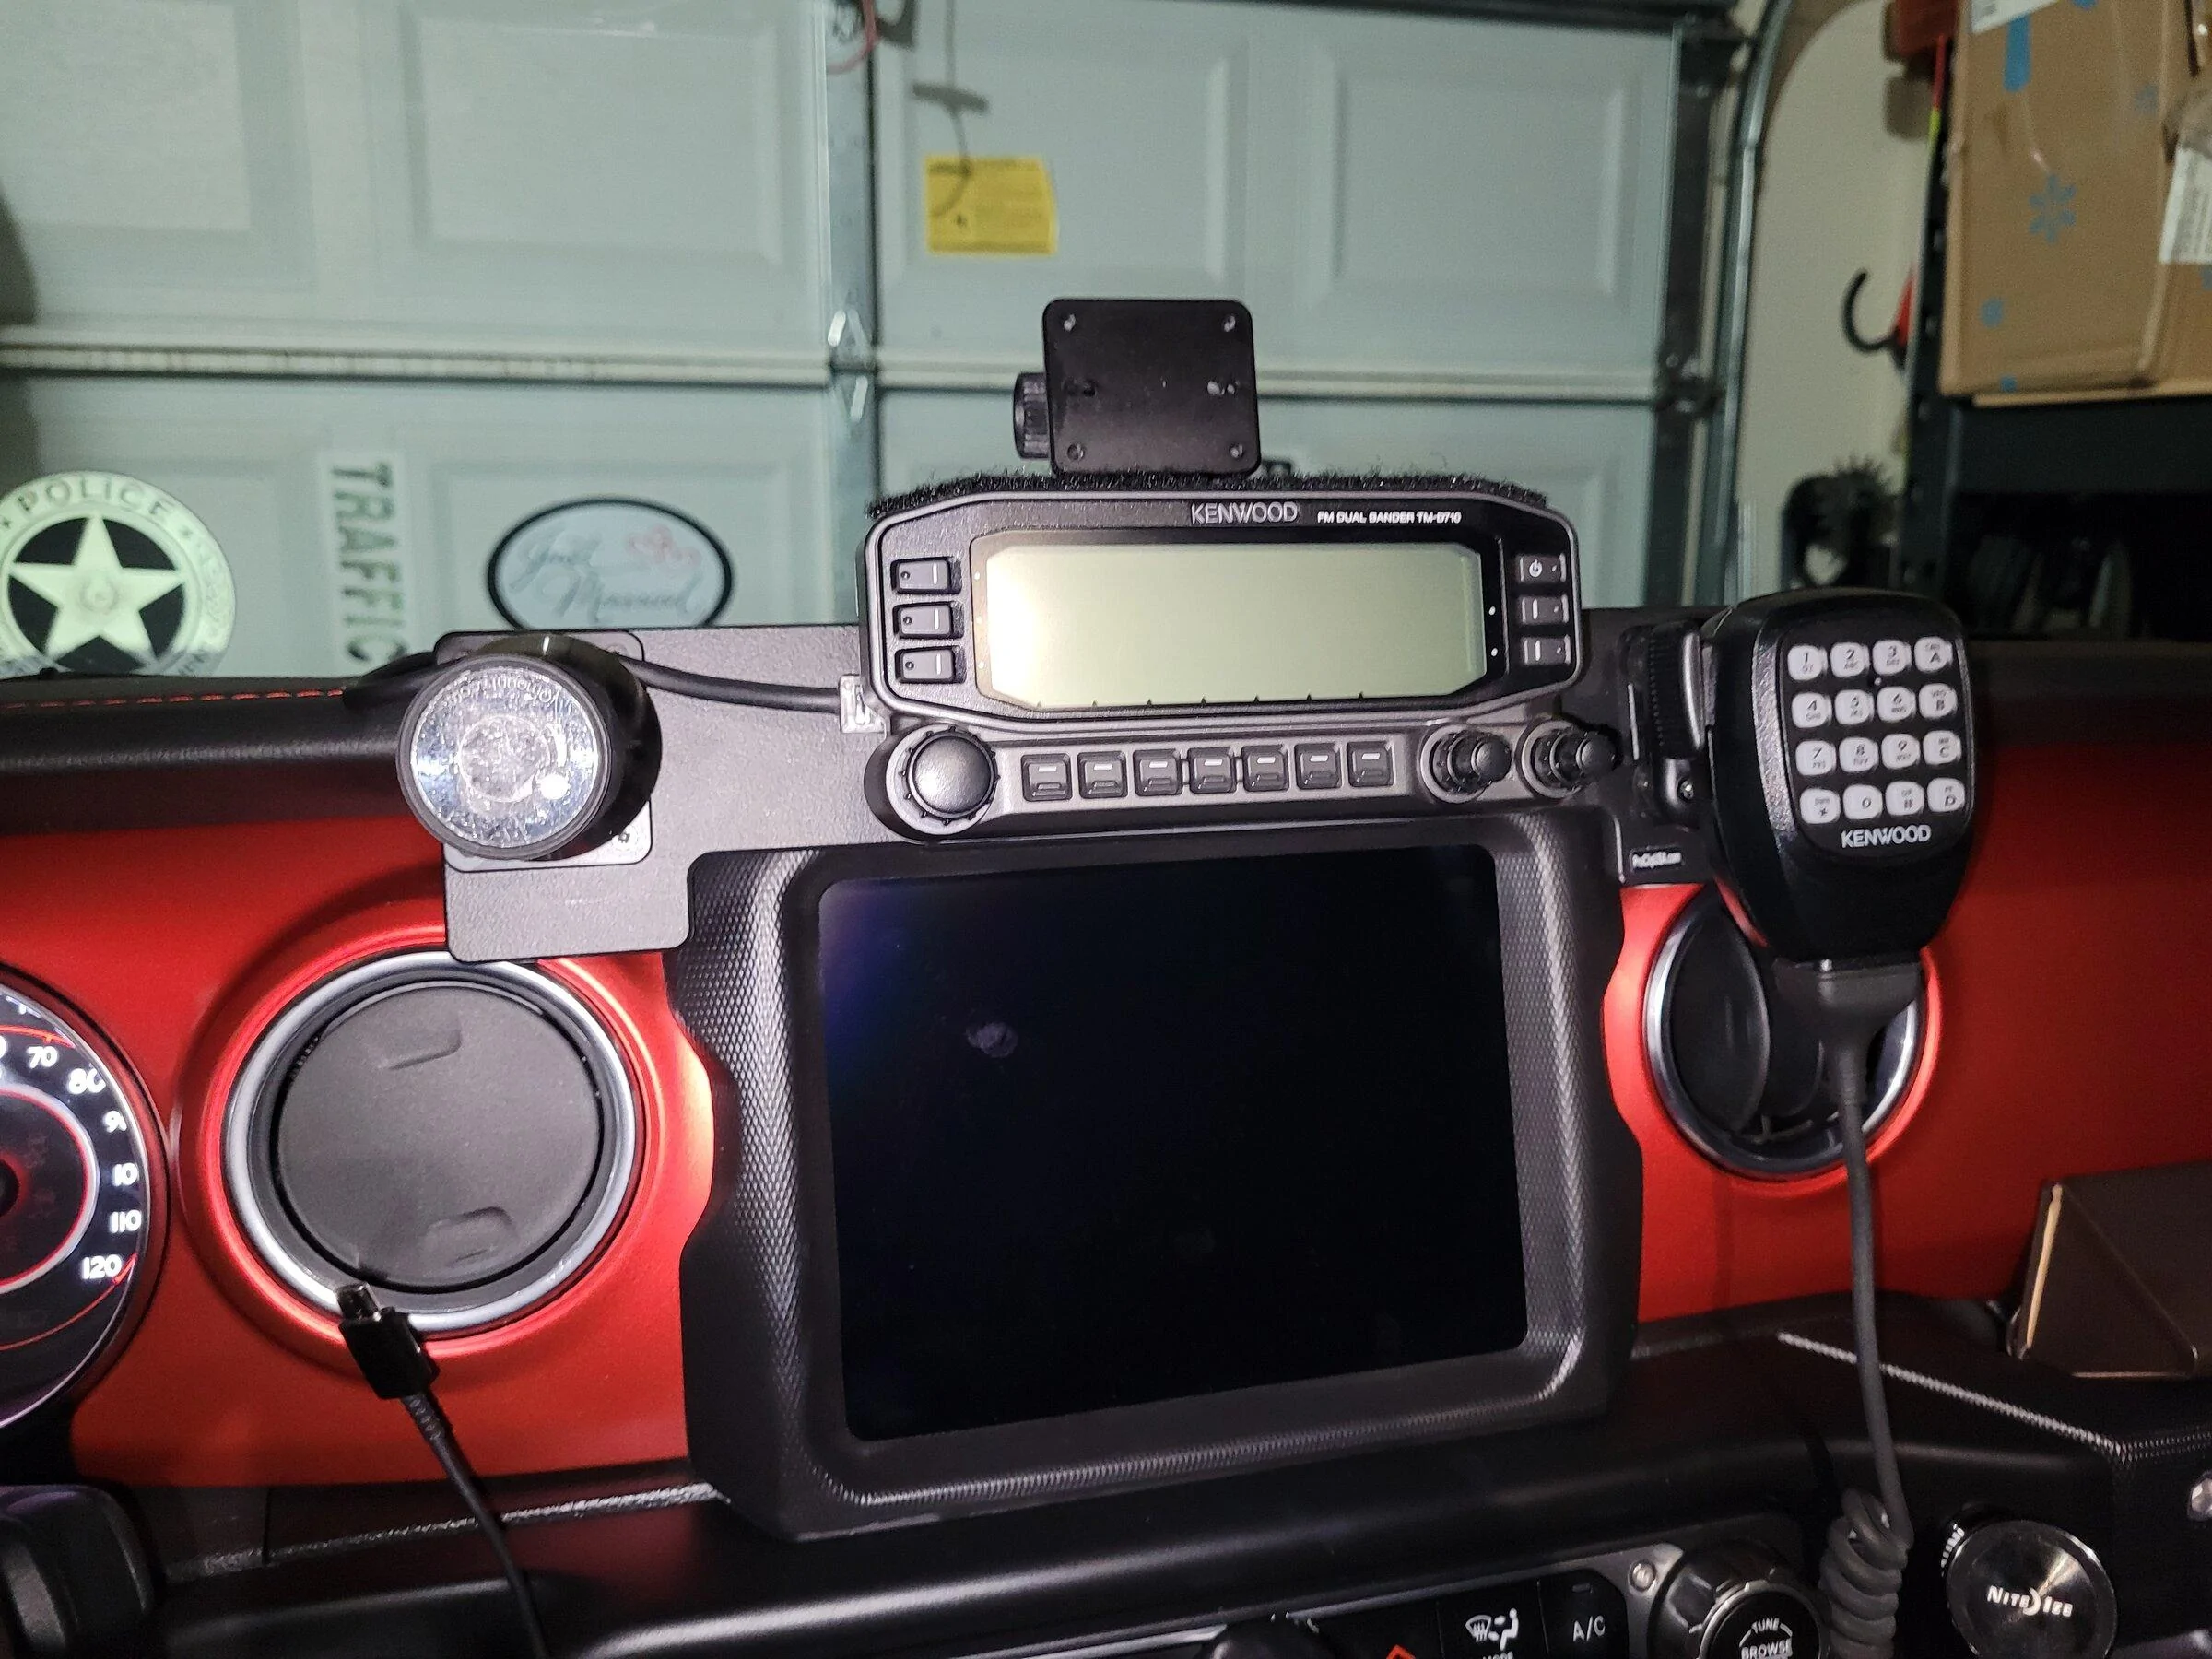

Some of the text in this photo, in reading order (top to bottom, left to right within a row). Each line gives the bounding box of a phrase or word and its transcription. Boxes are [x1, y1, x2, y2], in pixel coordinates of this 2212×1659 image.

[17, 476, 173, 521] POLICE
[1191, 501, 1299, 524] KENWOOD
[1317, 512, 1335, 524] FM
[1336, 512, 1367, 524] DUAL
[1369, 511, 1415, 524] BANDER
[332, 463, 407, 662] TRAFFIC
[1812, 747, 1823, 759] 7
[1944, 794, 1958, 807] D
[1841, 824, 1932, 848] KENWOOD
[27, 1045, 58, 1069] 70
[110, 1209, 142, 1233] 110
[81, 1253, 123, 1279] 120
[1573, 1615, 1606, 1641] A/C
[1751, 1618, 1780, 1634] TUNE
[1741, 1636, 1793, 1659] BROWSE
